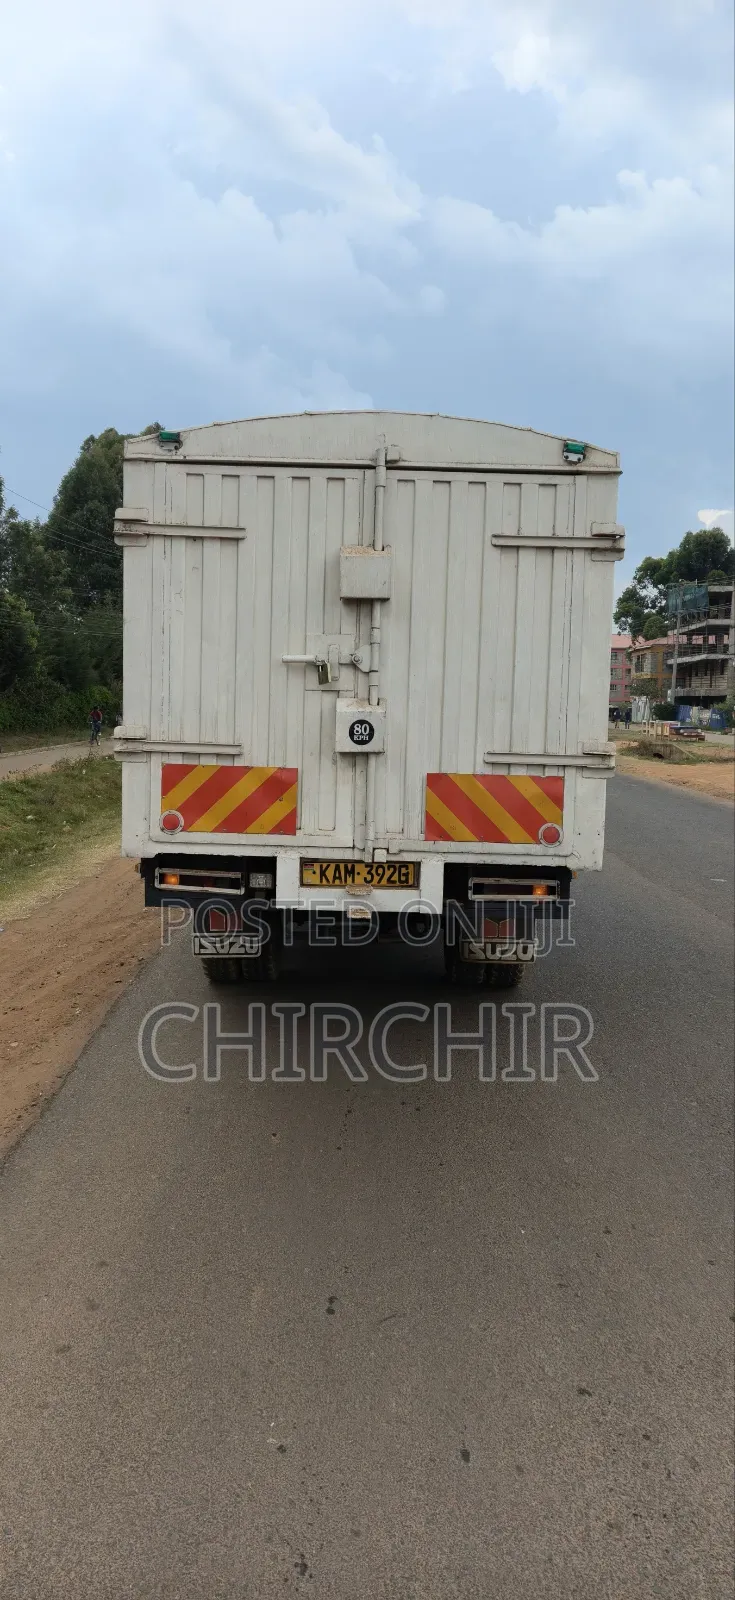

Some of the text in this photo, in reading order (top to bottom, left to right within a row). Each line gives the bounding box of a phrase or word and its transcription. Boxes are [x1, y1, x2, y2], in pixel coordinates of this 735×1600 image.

[353, 723, 370, 735] 80
[319, 863, 410, 885] KAM 392G
[193, 936, 260, 954] ISUZU
[463, 942, 534, 961] ISUZU
